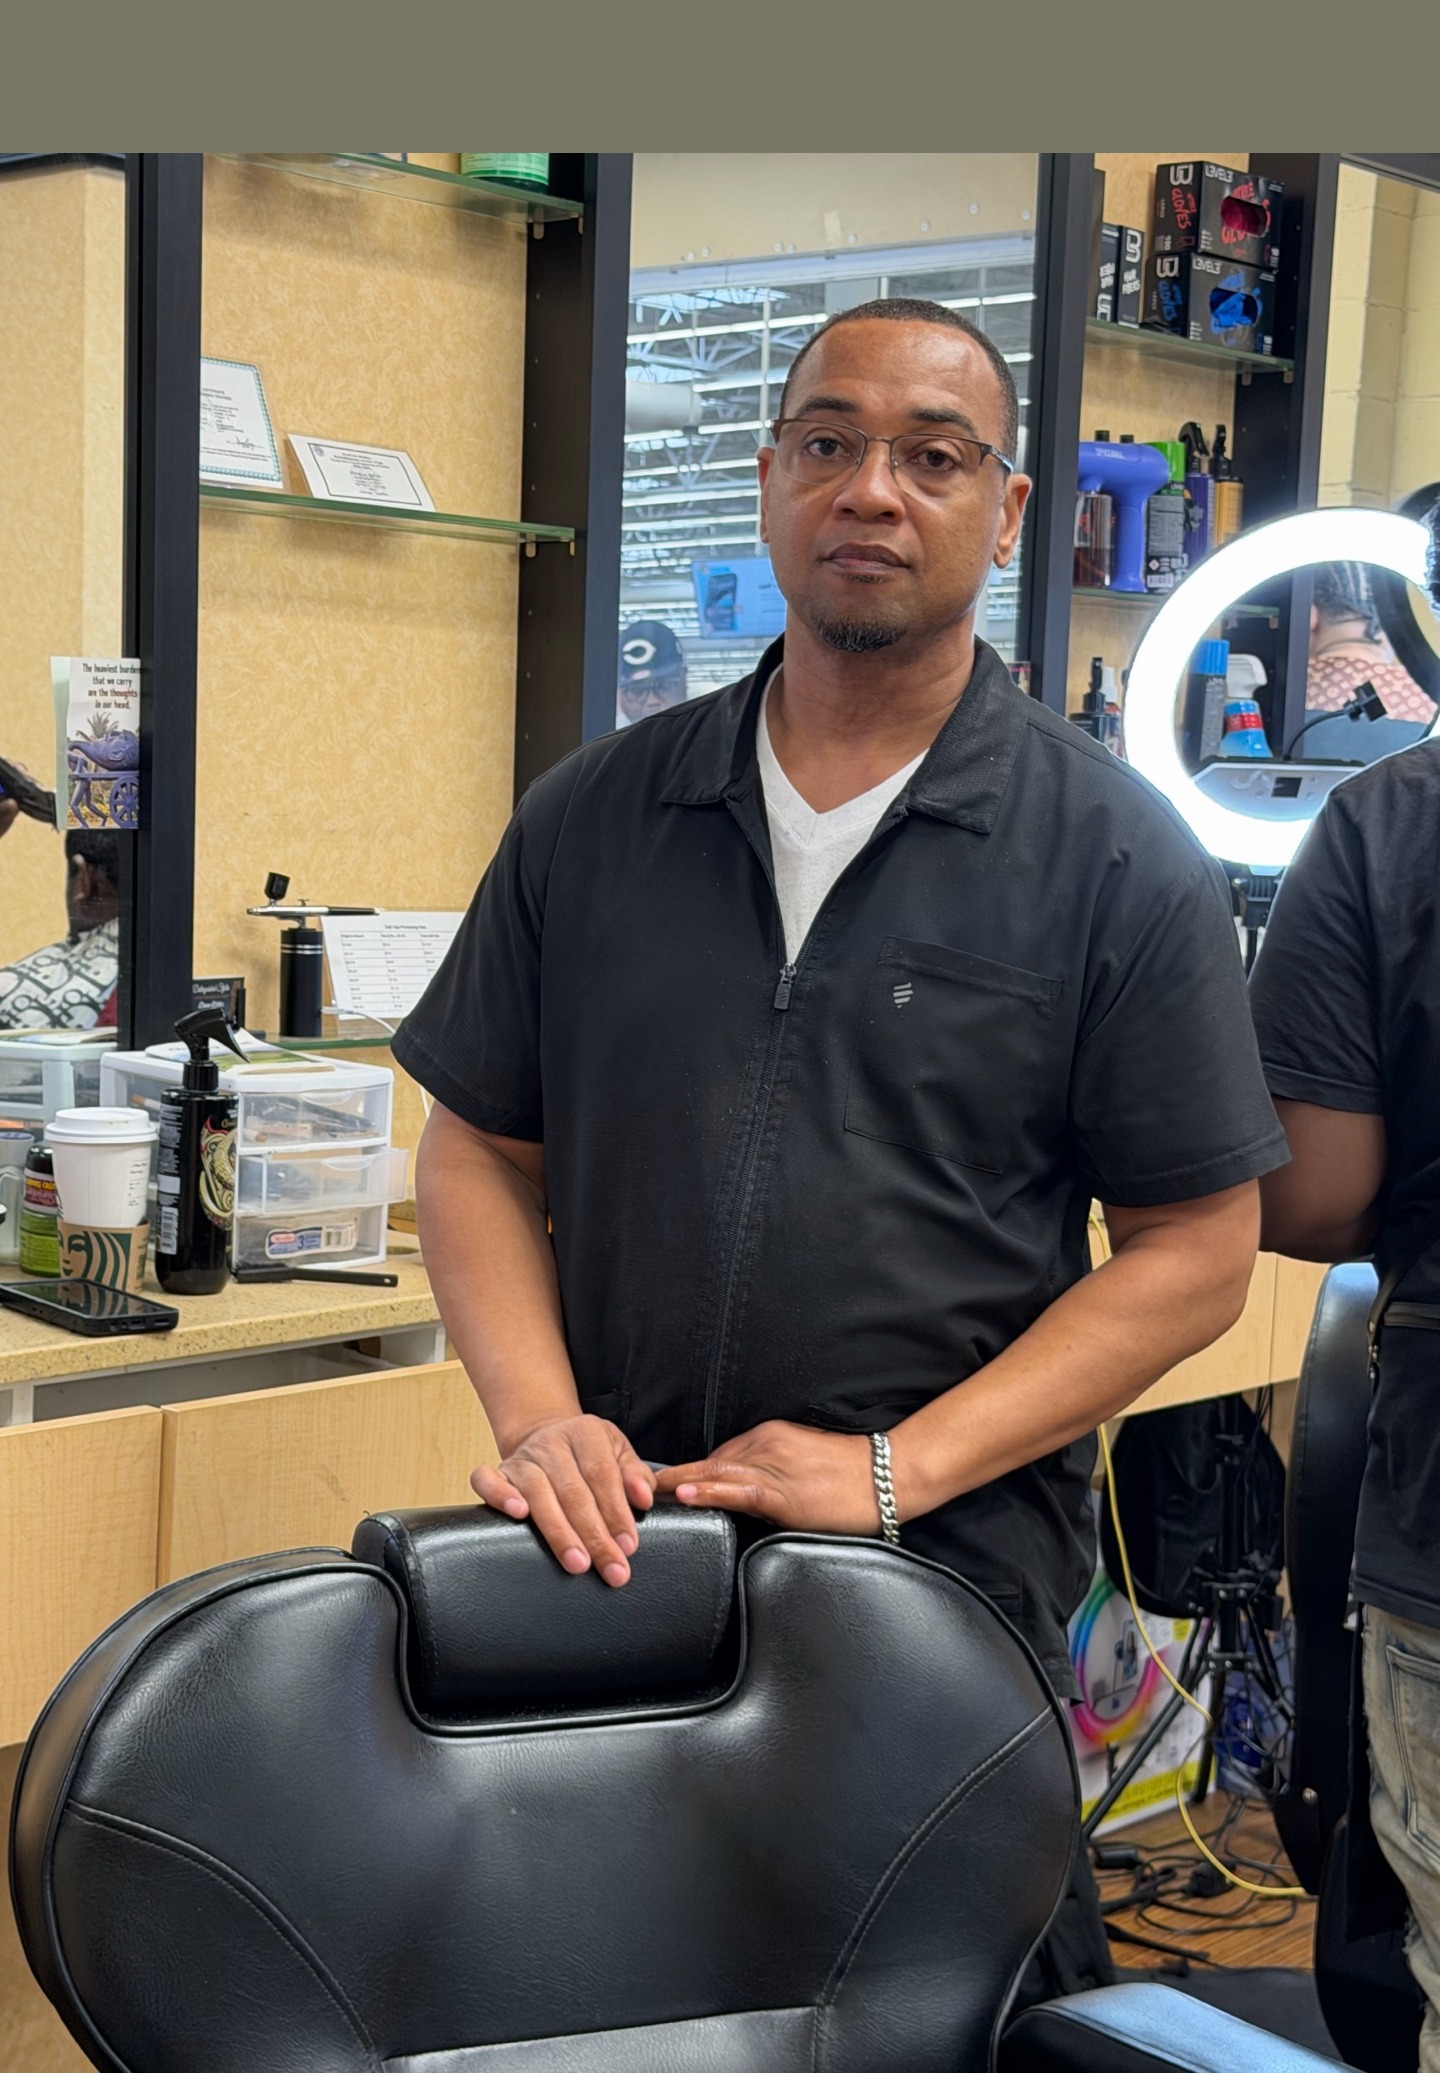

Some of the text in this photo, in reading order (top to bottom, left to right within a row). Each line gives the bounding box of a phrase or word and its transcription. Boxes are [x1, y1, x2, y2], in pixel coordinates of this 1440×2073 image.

[82, 663, 92, 673] The
[94, 664, 118, 673] heaviest
[92, 676, 105, 685] that
[116, 679, 132, 688] carry
[99, 688, 108, 697] the
[110, 688, 138, 700] thoughts
[95, 700, 101, 709] in
[114, 700, 131, 709] head.
[297, 1234, 305, 1250] 3
